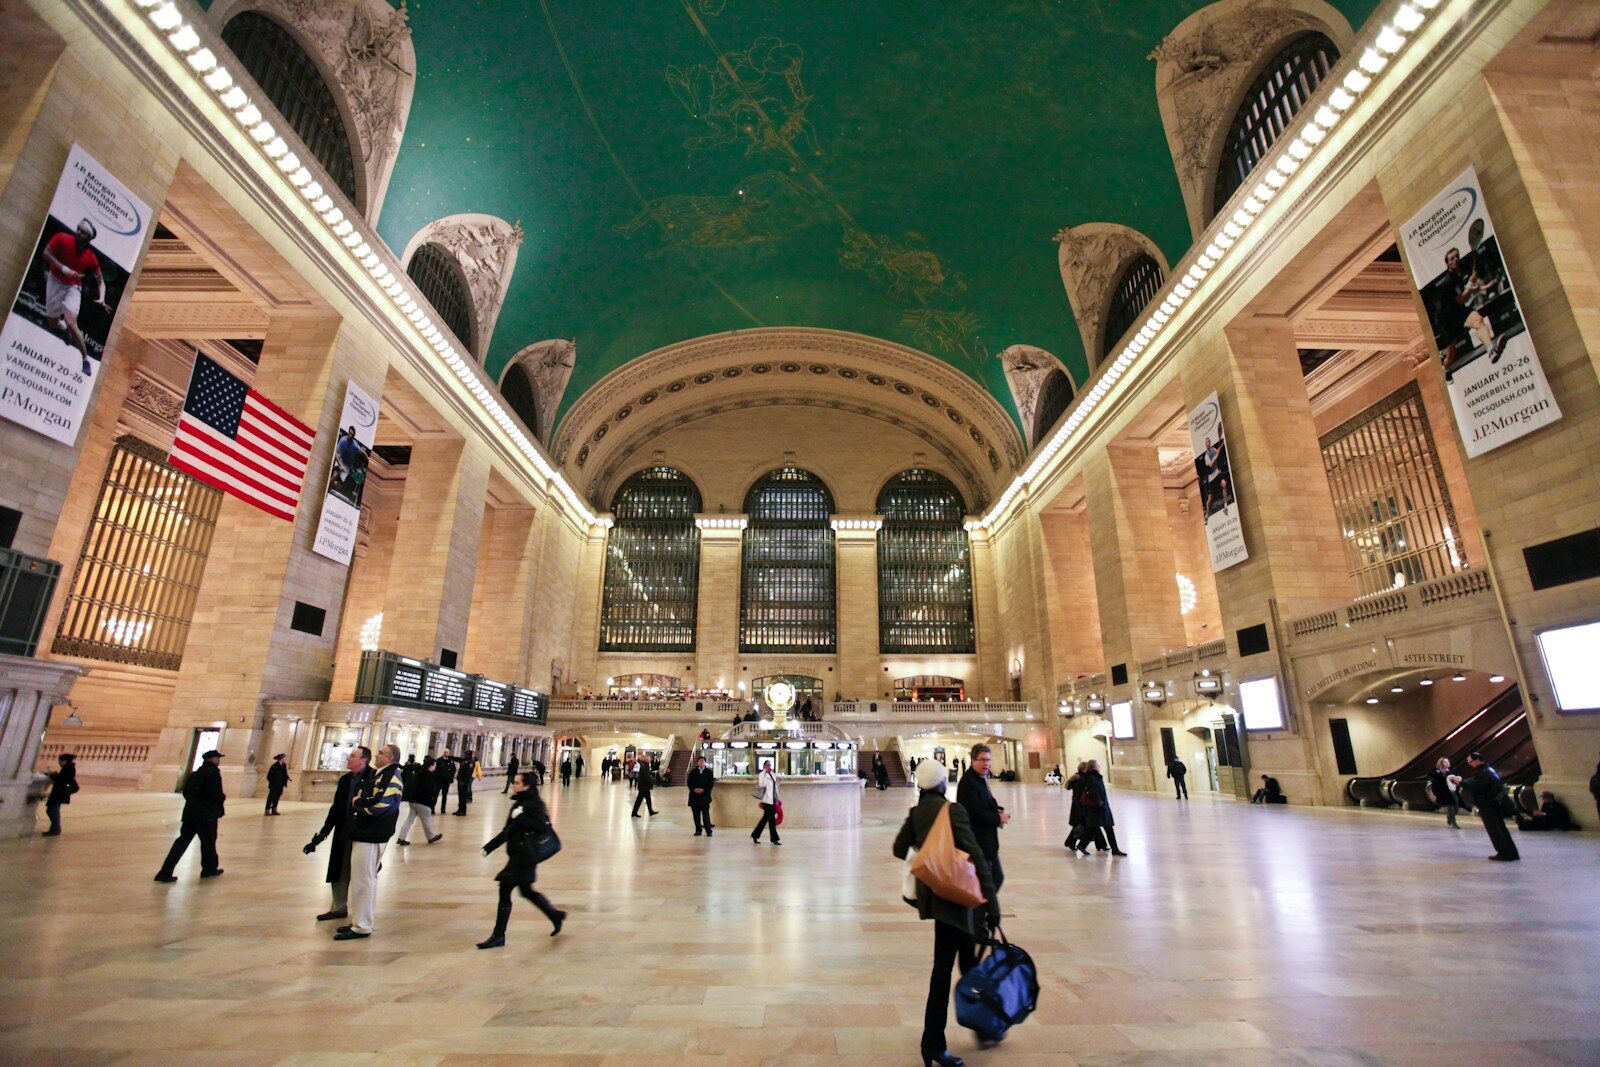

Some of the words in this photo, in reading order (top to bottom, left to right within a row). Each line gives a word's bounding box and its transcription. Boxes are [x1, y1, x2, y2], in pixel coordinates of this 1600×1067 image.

[84, 177, 129, 218] Tournament
[87, 171, 116, 199] Morgan
[1418, 207, 1444, 232] Morgan
[1420, 201, 1462, 238] Tournament
[6, 353, 59, 385] VANDERBILT
[59, 381, 79, 396] HALL
[11, 340, 57, 368] JANUARY
[57, 363, 83, 384] 20-26
[1464, 371, 1500, 397] JANUARY
[1502, 355, 1531, 377] 20-26
[5, 368, 72, 407] TOCSQUASH.COM
[1466, 382, 1511, 408] VANDERBILT
[1513, 369, 1535, 384] HALL
[1473, 383, 1536, 419] TOCSQUASH.COM
[1427, 653, 1466, 664] STREET
[1305, 684, 1318, 697] THE
[1317, 671, 1343, 689] METLIFE
[1343, 660, 1377, 677] BUILDING
